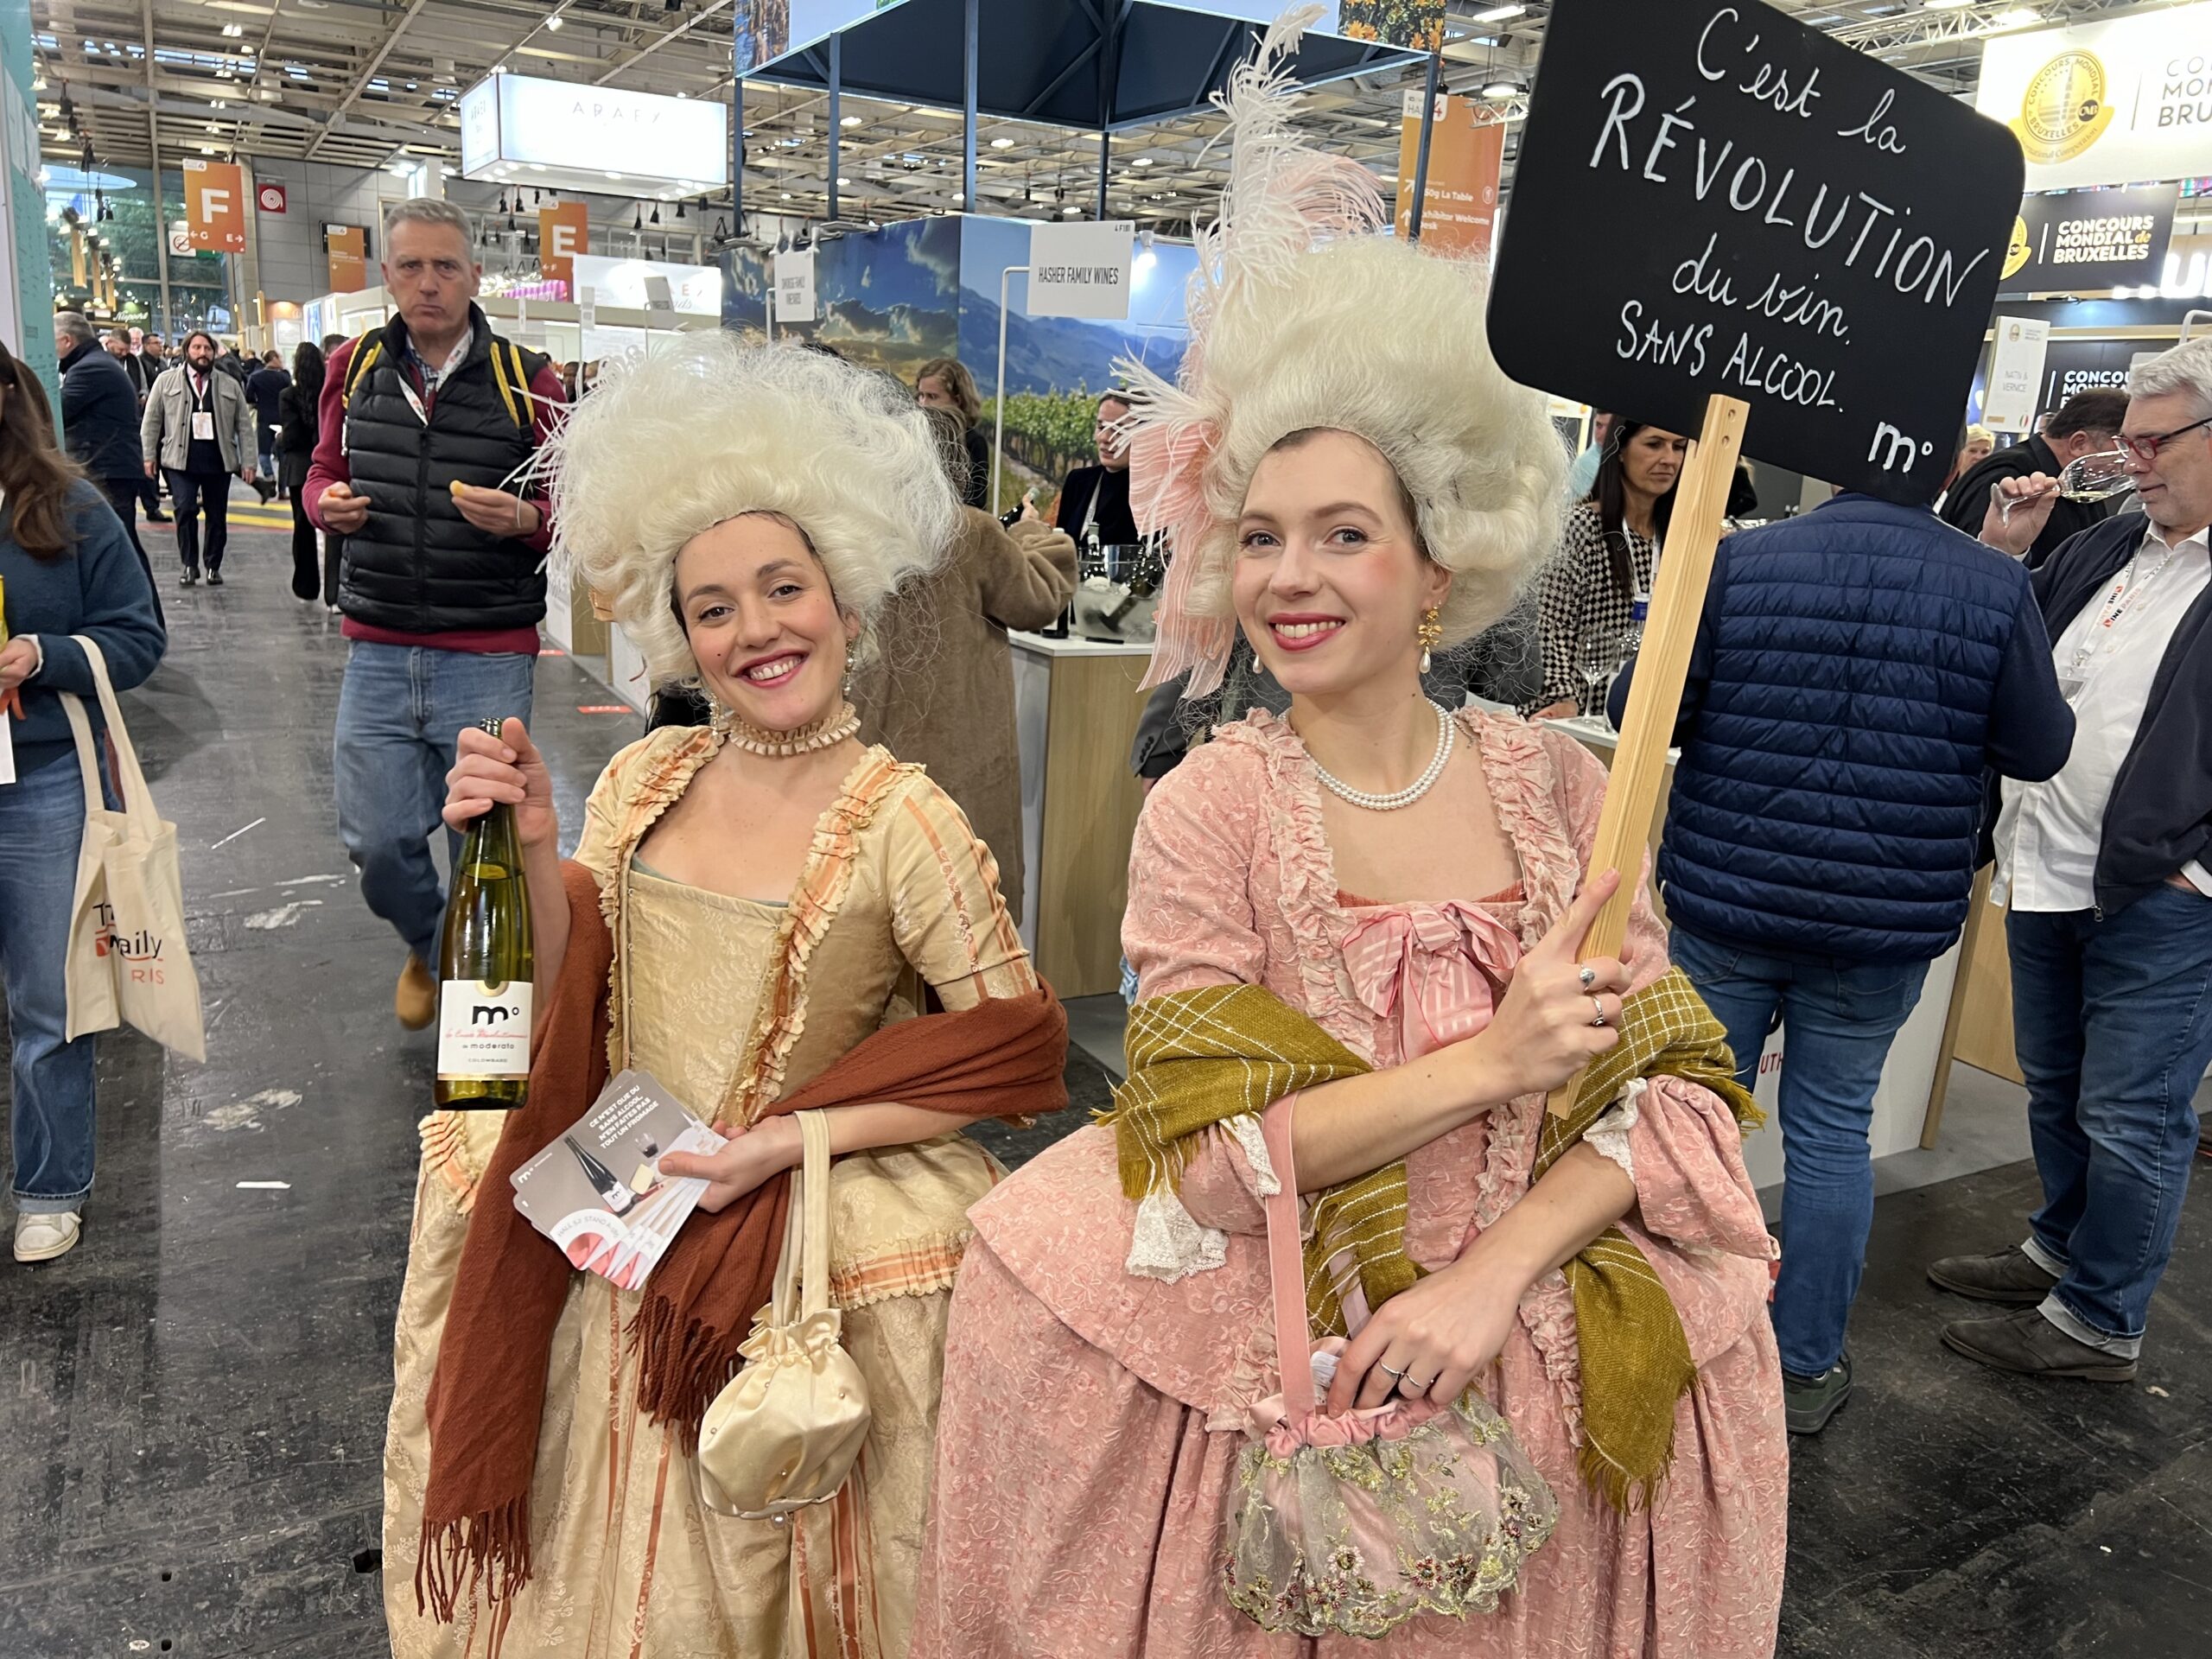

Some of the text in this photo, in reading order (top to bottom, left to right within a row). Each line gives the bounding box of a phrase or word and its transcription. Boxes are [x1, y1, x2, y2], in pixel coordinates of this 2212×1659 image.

[1697, 8, 1906, 154] C'est la
[200, 188, 230, 224] F
[2057, 215, 2155, 235] CONCOURS
[551, 224, 577, 258] E
[2056, 230, 2152, 248] MONDIAL de
[2053, 245, 2151, 264] BRUXELLES
[1038, 266, 1120, 285] HASHER FAMILY WINES
[1672, 232, 1738, 307] du
[1617, 300, 1714, 376] SANS
[130, 968, 164, 985] RIS
[629, 1084, 640, 1096] DU
[600, 1100, 659, 1149] TOUT UN FROMAGE
